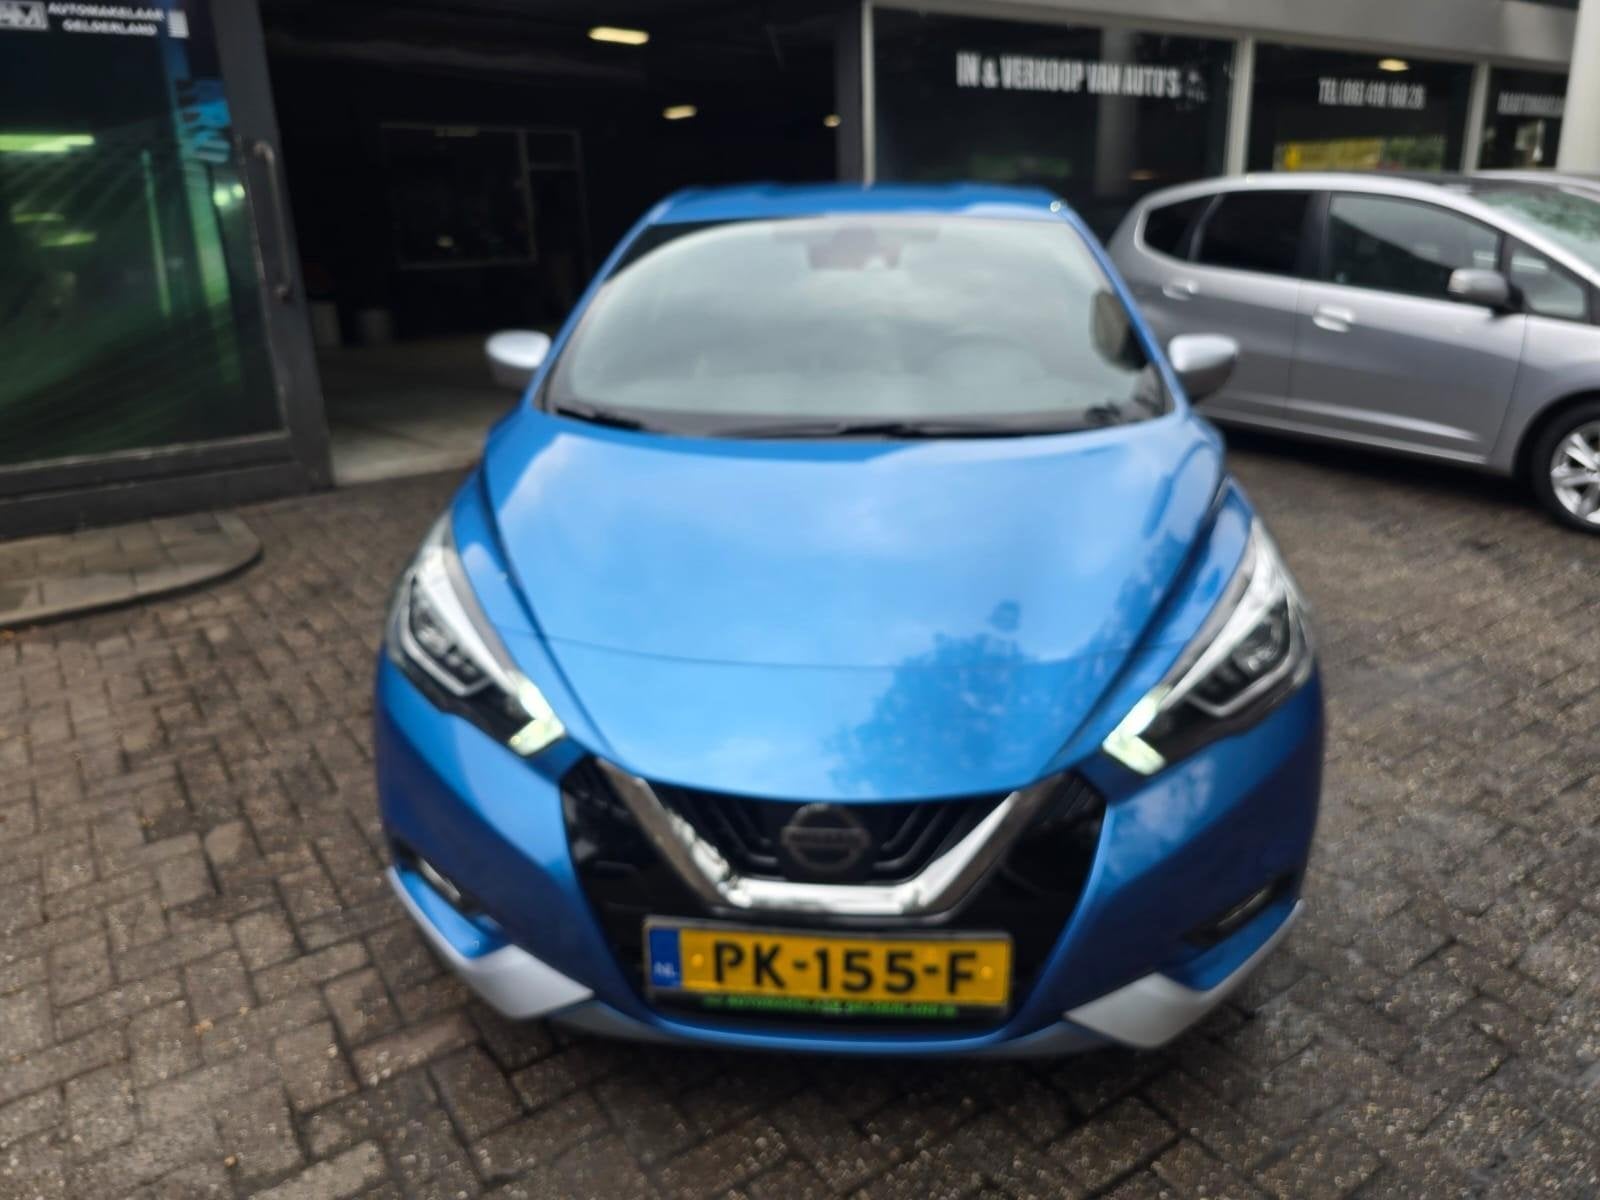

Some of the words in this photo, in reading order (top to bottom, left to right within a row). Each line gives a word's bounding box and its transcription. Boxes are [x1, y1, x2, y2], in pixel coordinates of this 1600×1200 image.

[62, 18, 158, 37] GELDERLAND
[956, 52, 980, 87] IN
[982, 58, 998, 89] &
[1000, 55, 1083, 92] VERKOOP
[1085, 63, 1120, 95] VAN
[1121, 66, 1182, 98] AUTO'S
[713, 940, 978, 994] PK-155-F
